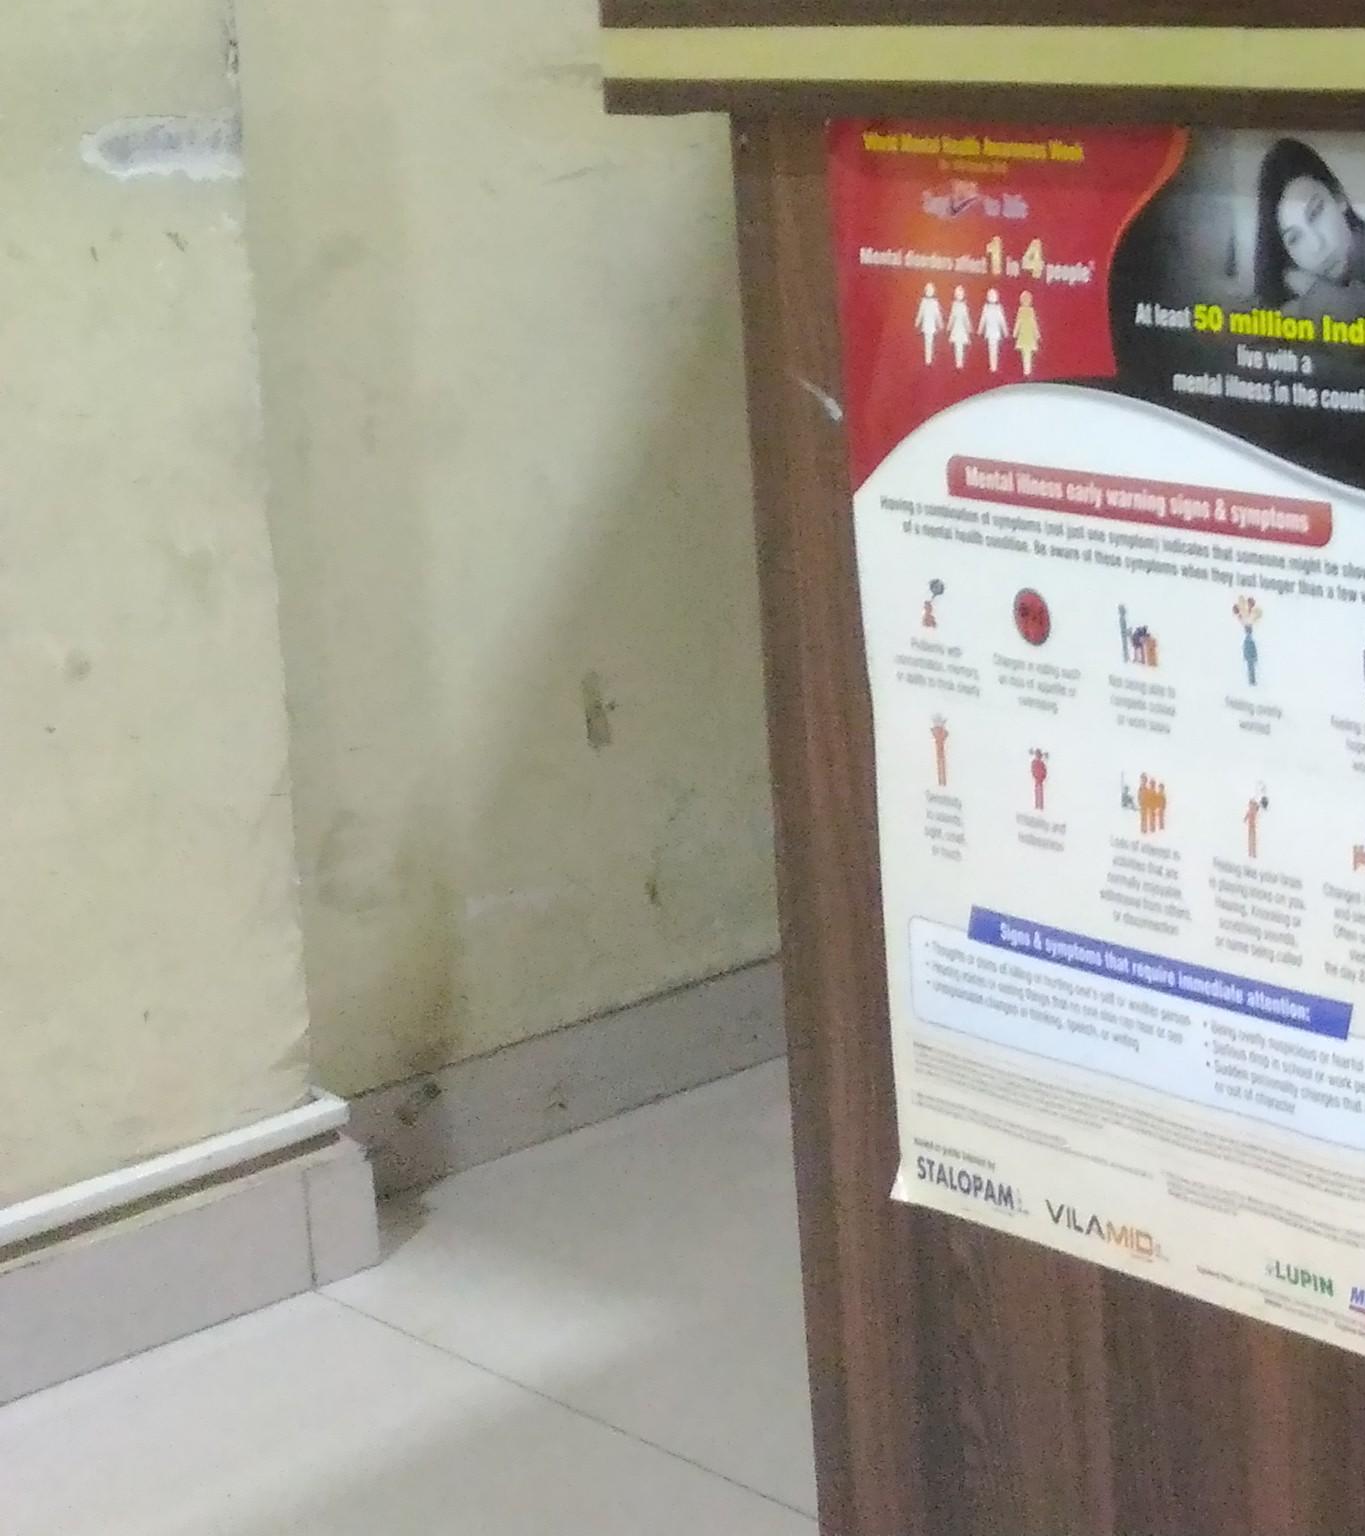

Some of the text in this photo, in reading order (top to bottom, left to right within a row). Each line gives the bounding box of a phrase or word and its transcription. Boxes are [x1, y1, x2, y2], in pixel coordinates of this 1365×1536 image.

[986, 235, 1003, 275] 1
[1021, 237, 1046, 280] 4
[1134, 301, 1153, 326] At
[1154, 302, 1192, 330] least
[1193, 303, 1224, 333] 50
[1229, 308, 1316, 342] million
[1236, 344, 1313, 375] live with a
[1172, 372, 1224, 397] mental
[1225, 374, 1272, 403] illness
[1274, 379, 1291, 404] in
[1292, 380, 1319, 408] the
[964, 464, 1014, 493] Mental
[1105, 486, 1168, 518] warning
[1214, 497, 1227, 522] &
[1000, 922, 1031, 949] Signs
[916, 1155, 1015, 1211] STALOPAM
[1046, 1199, 1153, 1256] VILAMID
[1274, 1261, 1335, 1298] LUPIN
